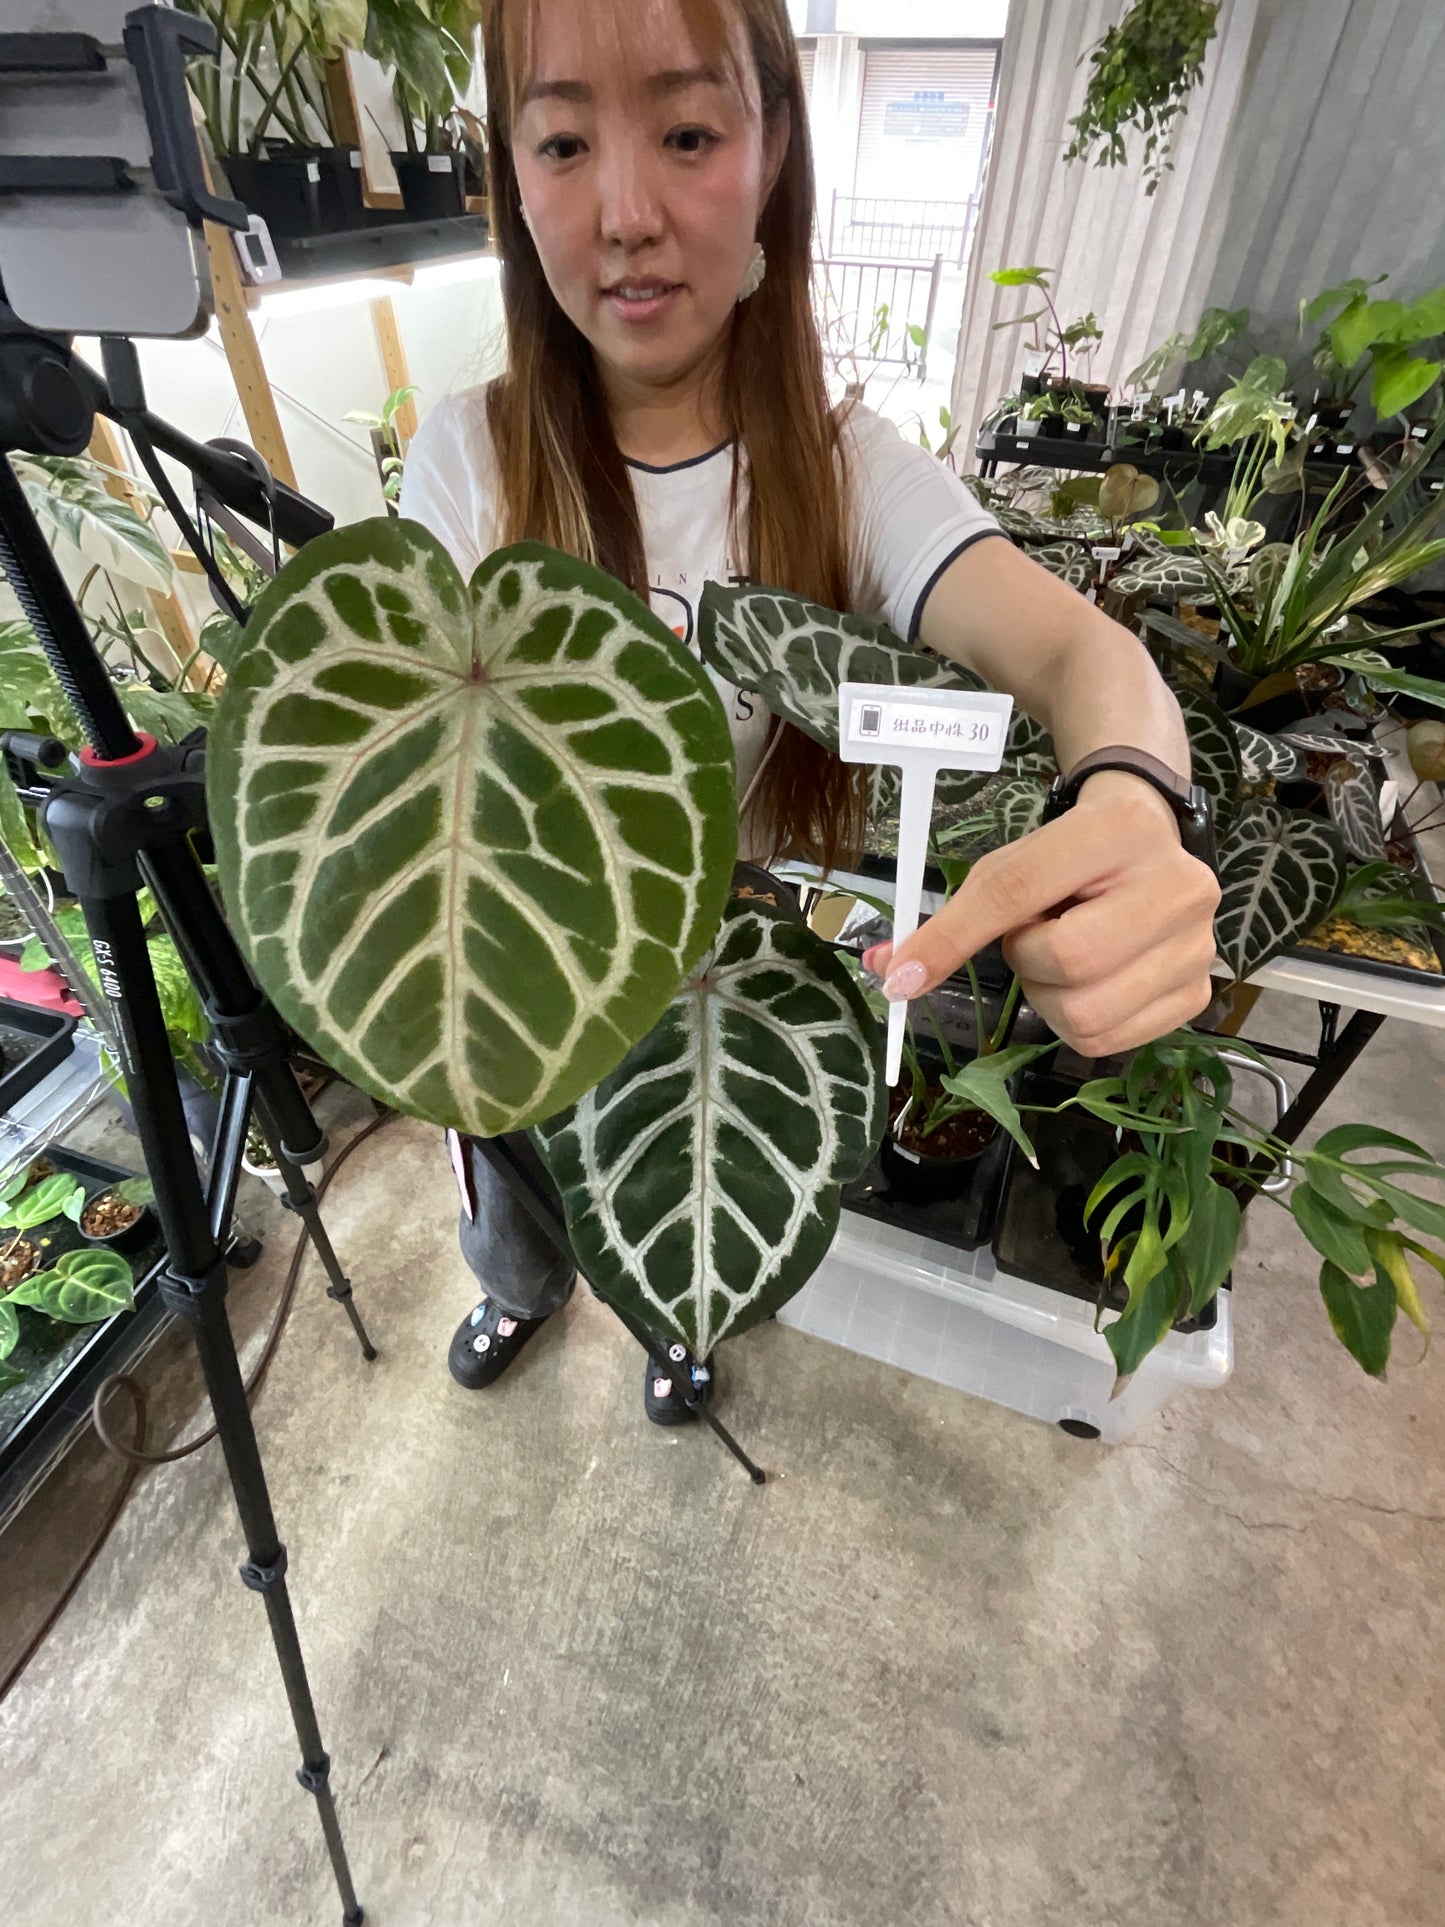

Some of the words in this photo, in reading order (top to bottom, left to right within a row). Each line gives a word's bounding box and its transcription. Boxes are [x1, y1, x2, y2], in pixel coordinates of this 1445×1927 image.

[969, 722, 990, 742] 30
[93, 940, 114, 966] GX-S
[100, 968, 122, 998] 6400
